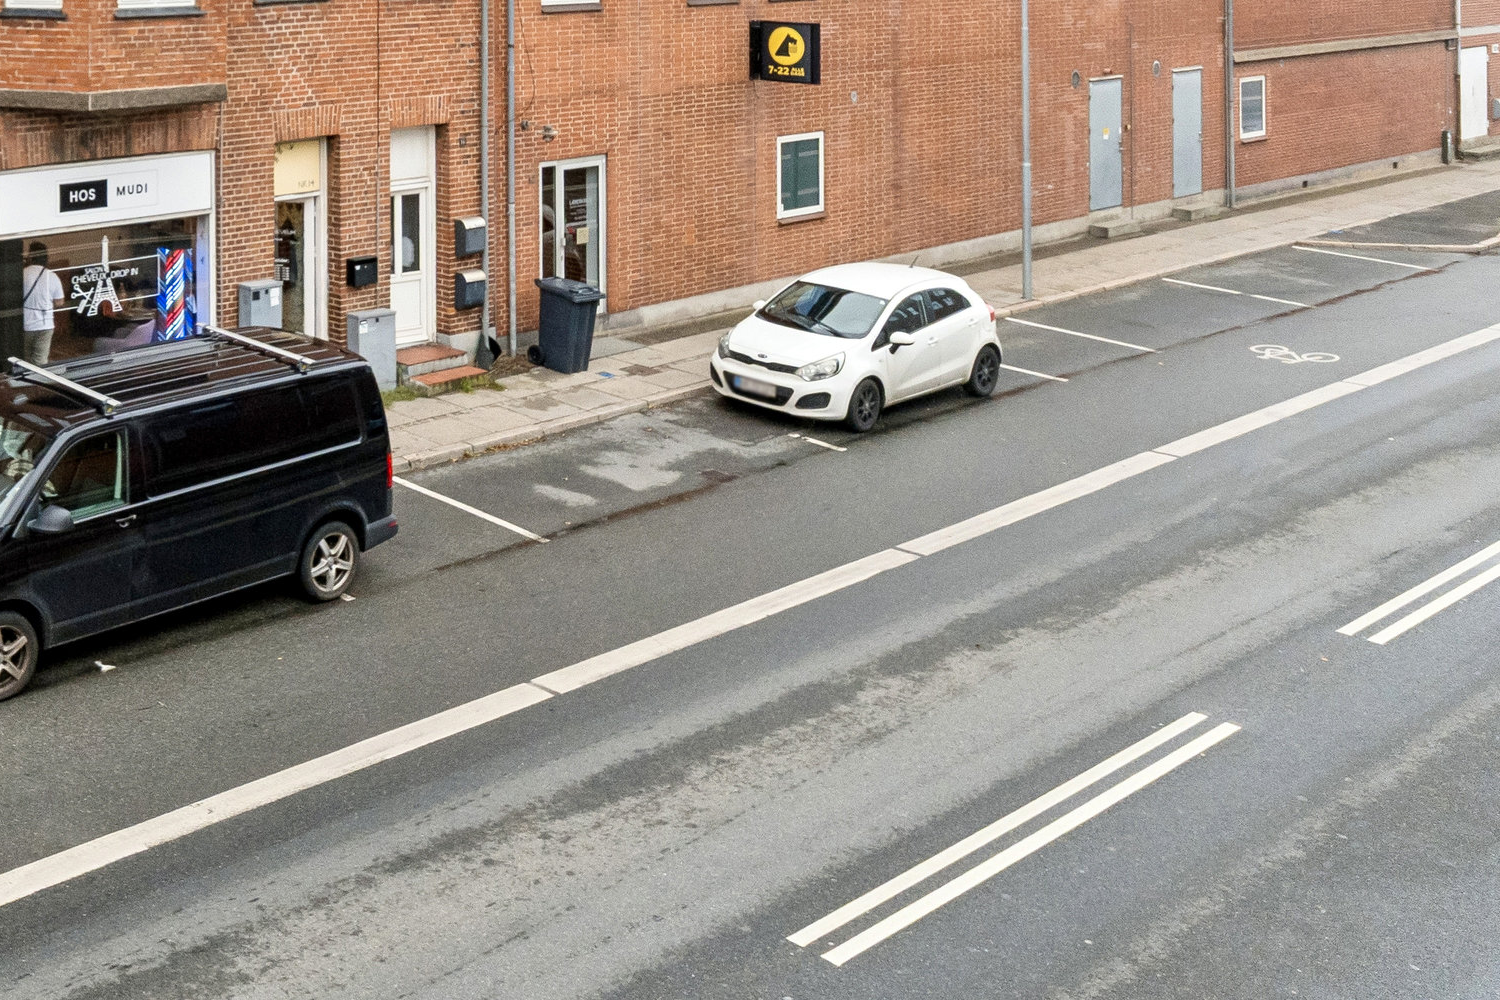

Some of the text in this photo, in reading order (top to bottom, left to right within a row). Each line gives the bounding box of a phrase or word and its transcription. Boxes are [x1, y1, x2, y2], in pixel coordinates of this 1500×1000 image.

[768, 64, 790, 76] 7-22
[69, 183, 148, 203] HOS MUDI
[110, 268, 130, 279] DROP
[130, 267, 139, 276] IN
